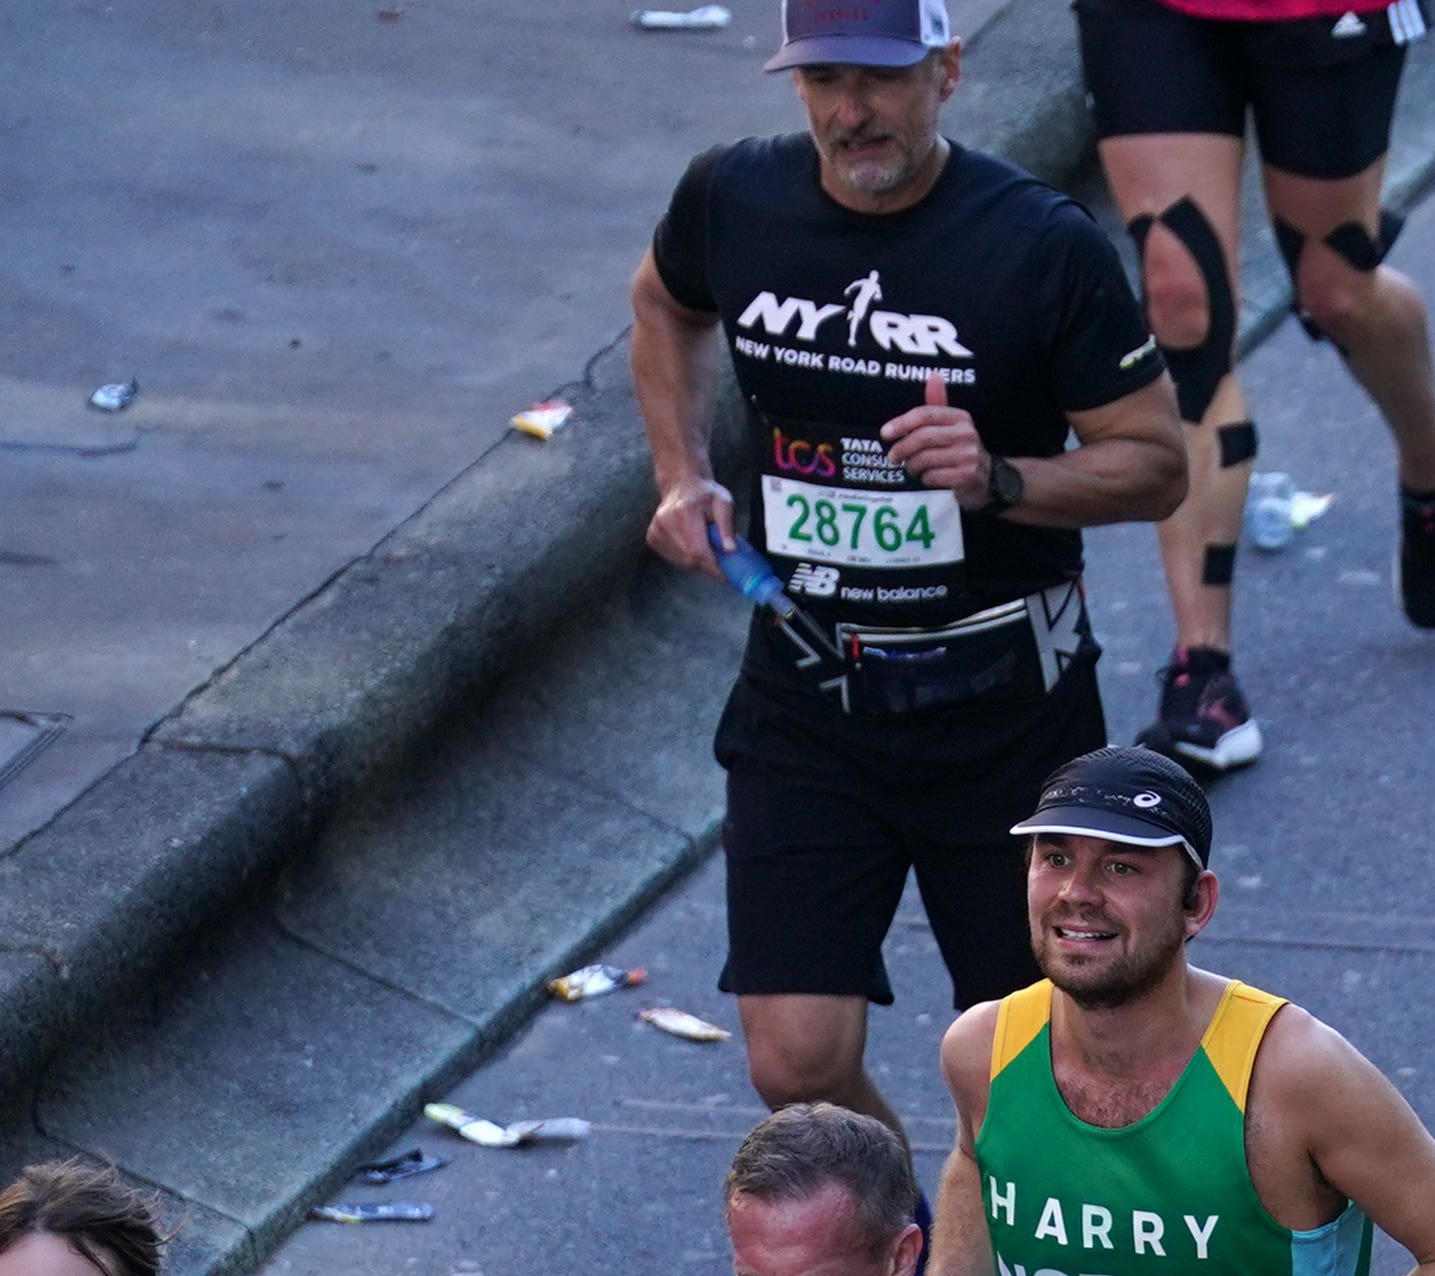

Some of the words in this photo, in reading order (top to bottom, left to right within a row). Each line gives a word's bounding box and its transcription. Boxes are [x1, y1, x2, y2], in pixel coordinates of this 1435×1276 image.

[735, 335, 769, 362] NEW
[773, 345, 825, 369] YORK
[828, 355, 881, 376] ROAD
[773, 426, 836, 477] tcs
[840, 437, 883, 453] TATA
[843, 466, 906, 483] SERVICES
[786, 494, 936, 552] 28764
[840, 586, 874, 602] new
[876, 582, 949, 602] balance
[988, 1174, 1220, 1260] HARRY
